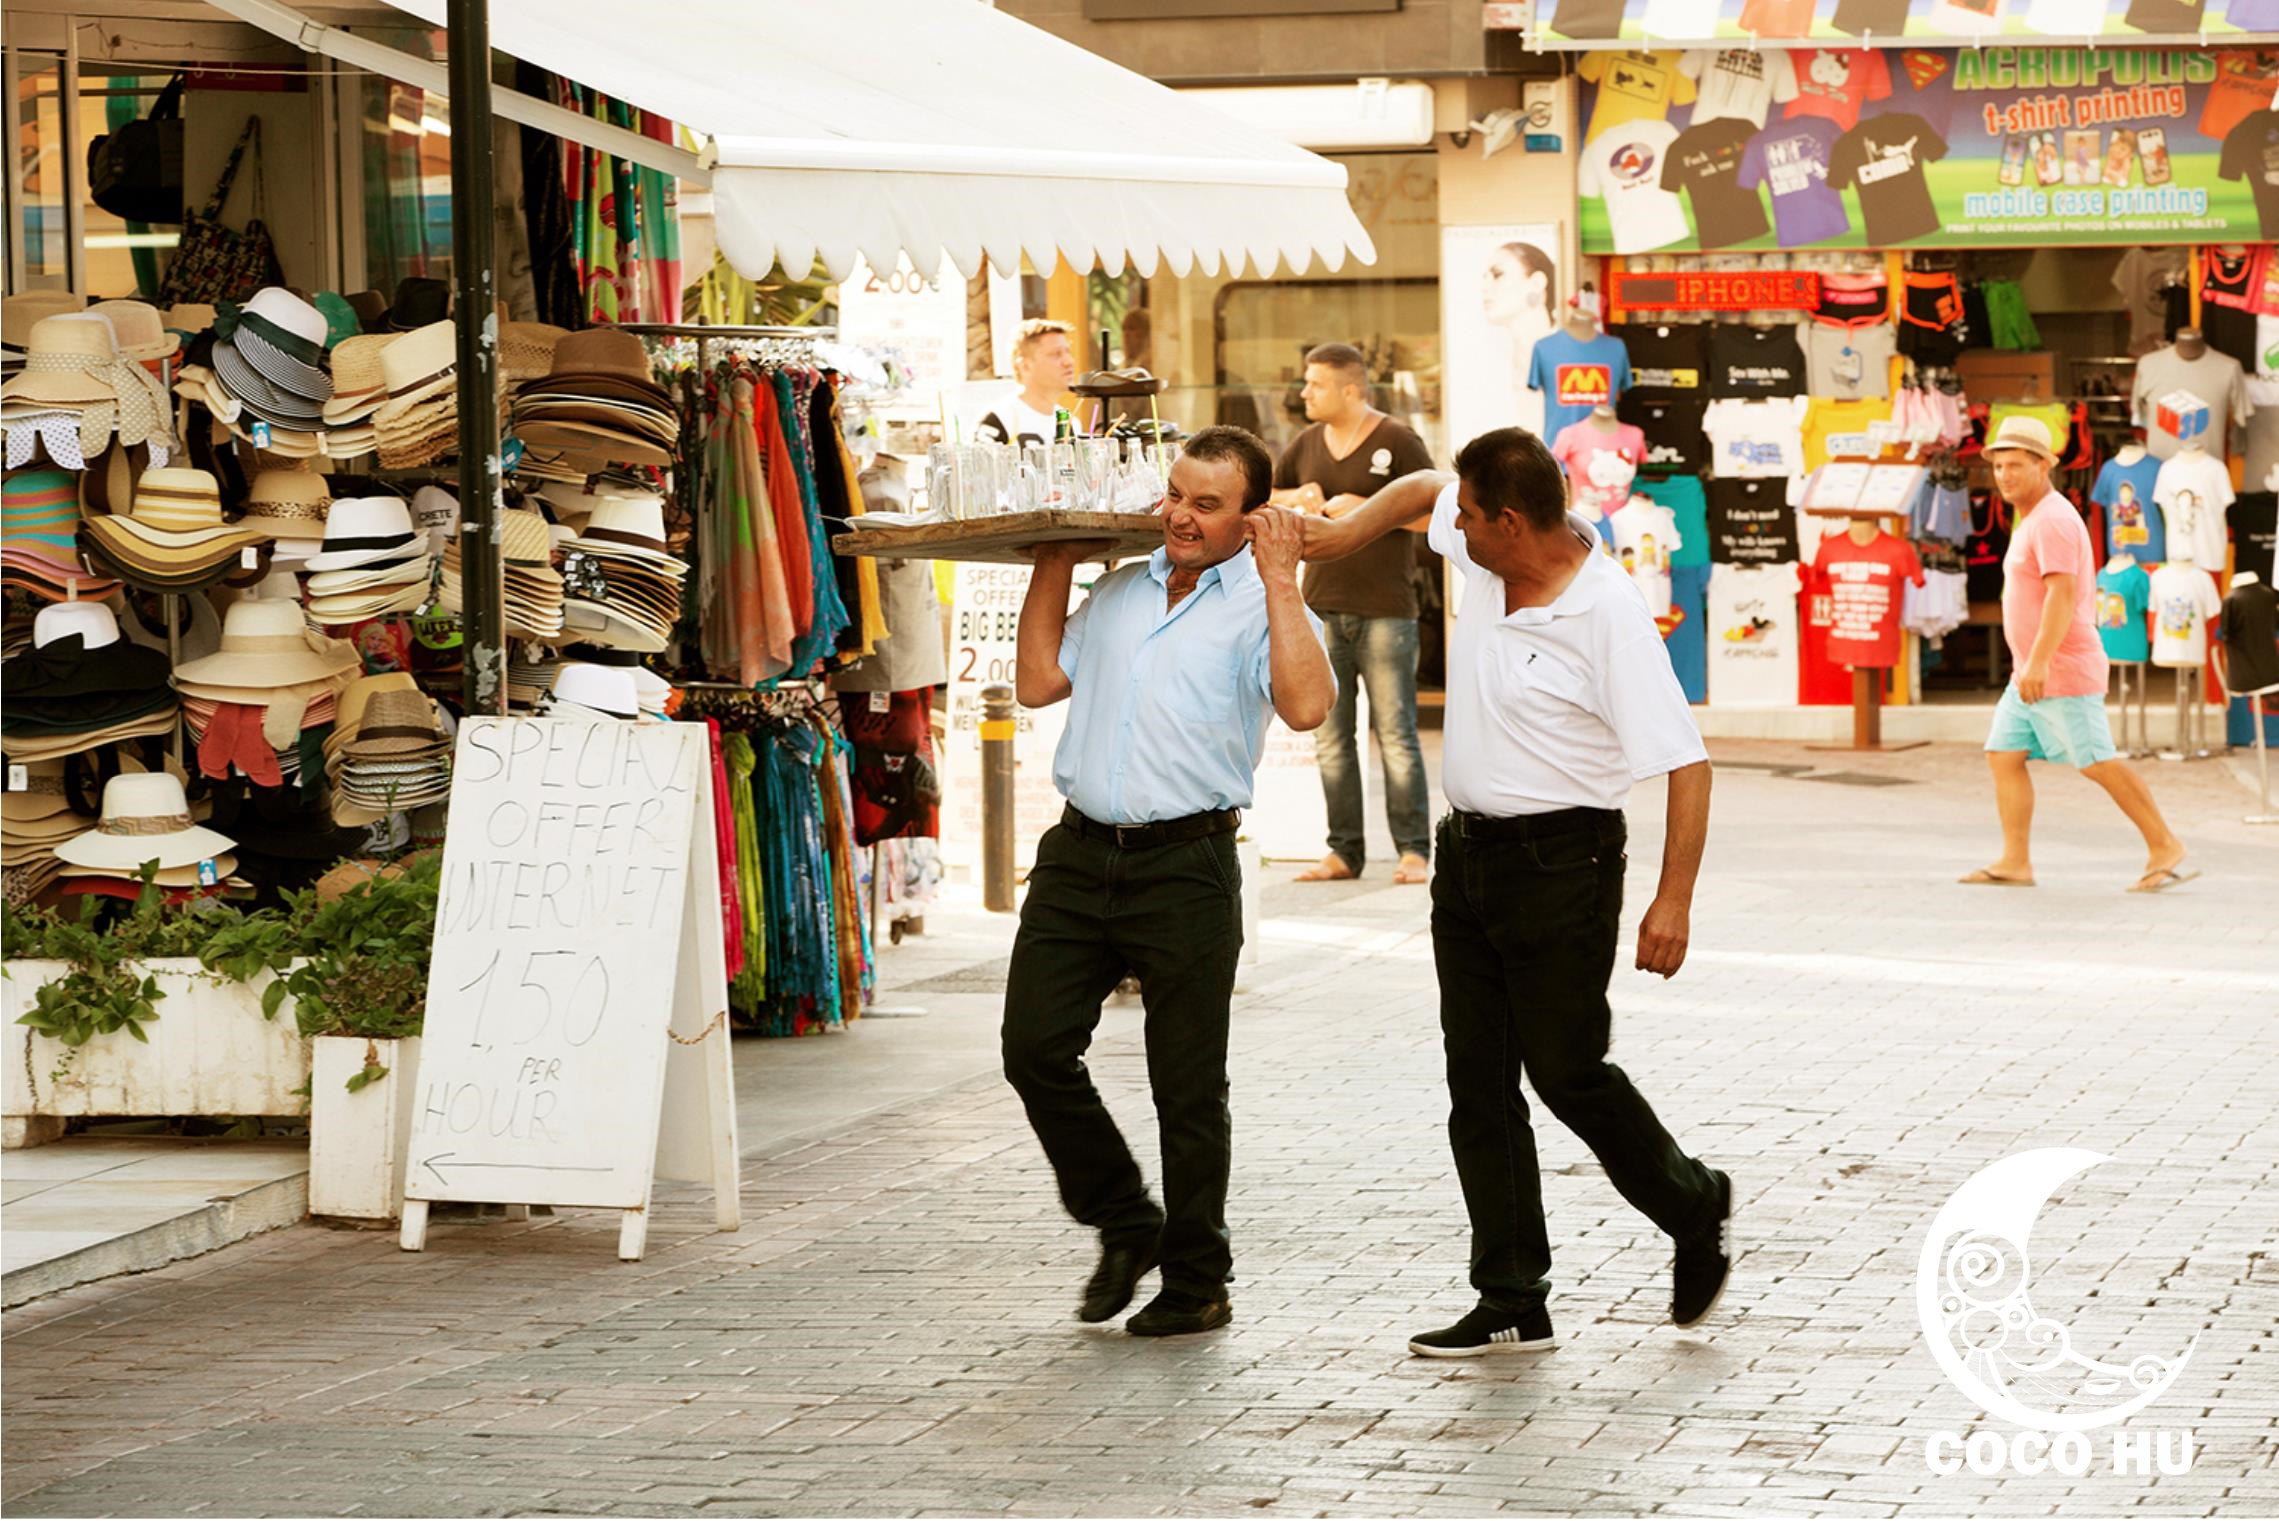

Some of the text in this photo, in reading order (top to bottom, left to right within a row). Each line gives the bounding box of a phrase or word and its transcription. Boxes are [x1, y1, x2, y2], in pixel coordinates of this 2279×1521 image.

[1953, 47, 2217, 90] ACROPOLIS
[1983, 94, 2071, 135] t-shirt
[2075, 84, 2186, 127] printing
[1965, 184, 2208, 217] mobile case printing
[967, 569, 1029, 586] SPECIA
[960, 611, 1017, 641] BIG BE
[463, 722, 688, 793] SPECIAL
[486, 798, 676, 856] OFFER
[441, 860, 678, 935] INTERNET
[459, 948, 610, 1052] 1,50
[519, 1056, 561, 1085] PER
[421, 1082, 560, 1144] HOUR
